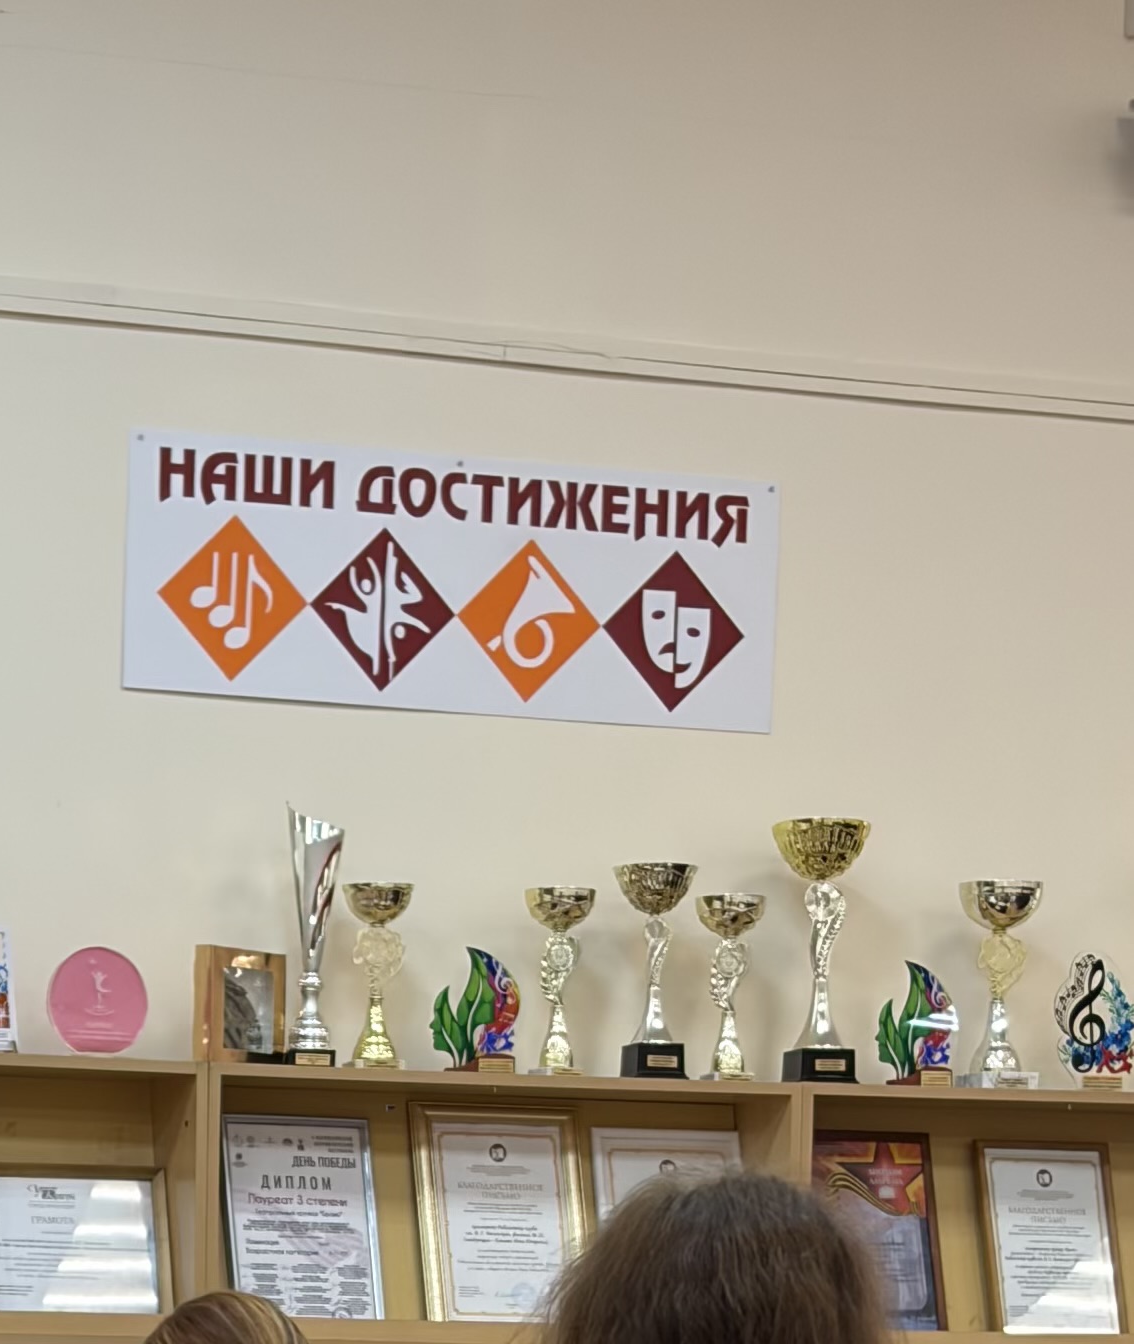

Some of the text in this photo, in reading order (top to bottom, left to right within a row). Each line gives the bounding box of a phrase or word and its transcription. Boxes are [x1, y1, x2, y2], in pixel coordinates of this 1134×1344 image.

[159, 446, 751, 549] НАШИ ДОСТИЖЕНИЯ
[292, 1155, 357, 1169] ДЕНЬ ПОБЕДЫ
[261, 1174, 332, 1191] ДИПЛОМ
